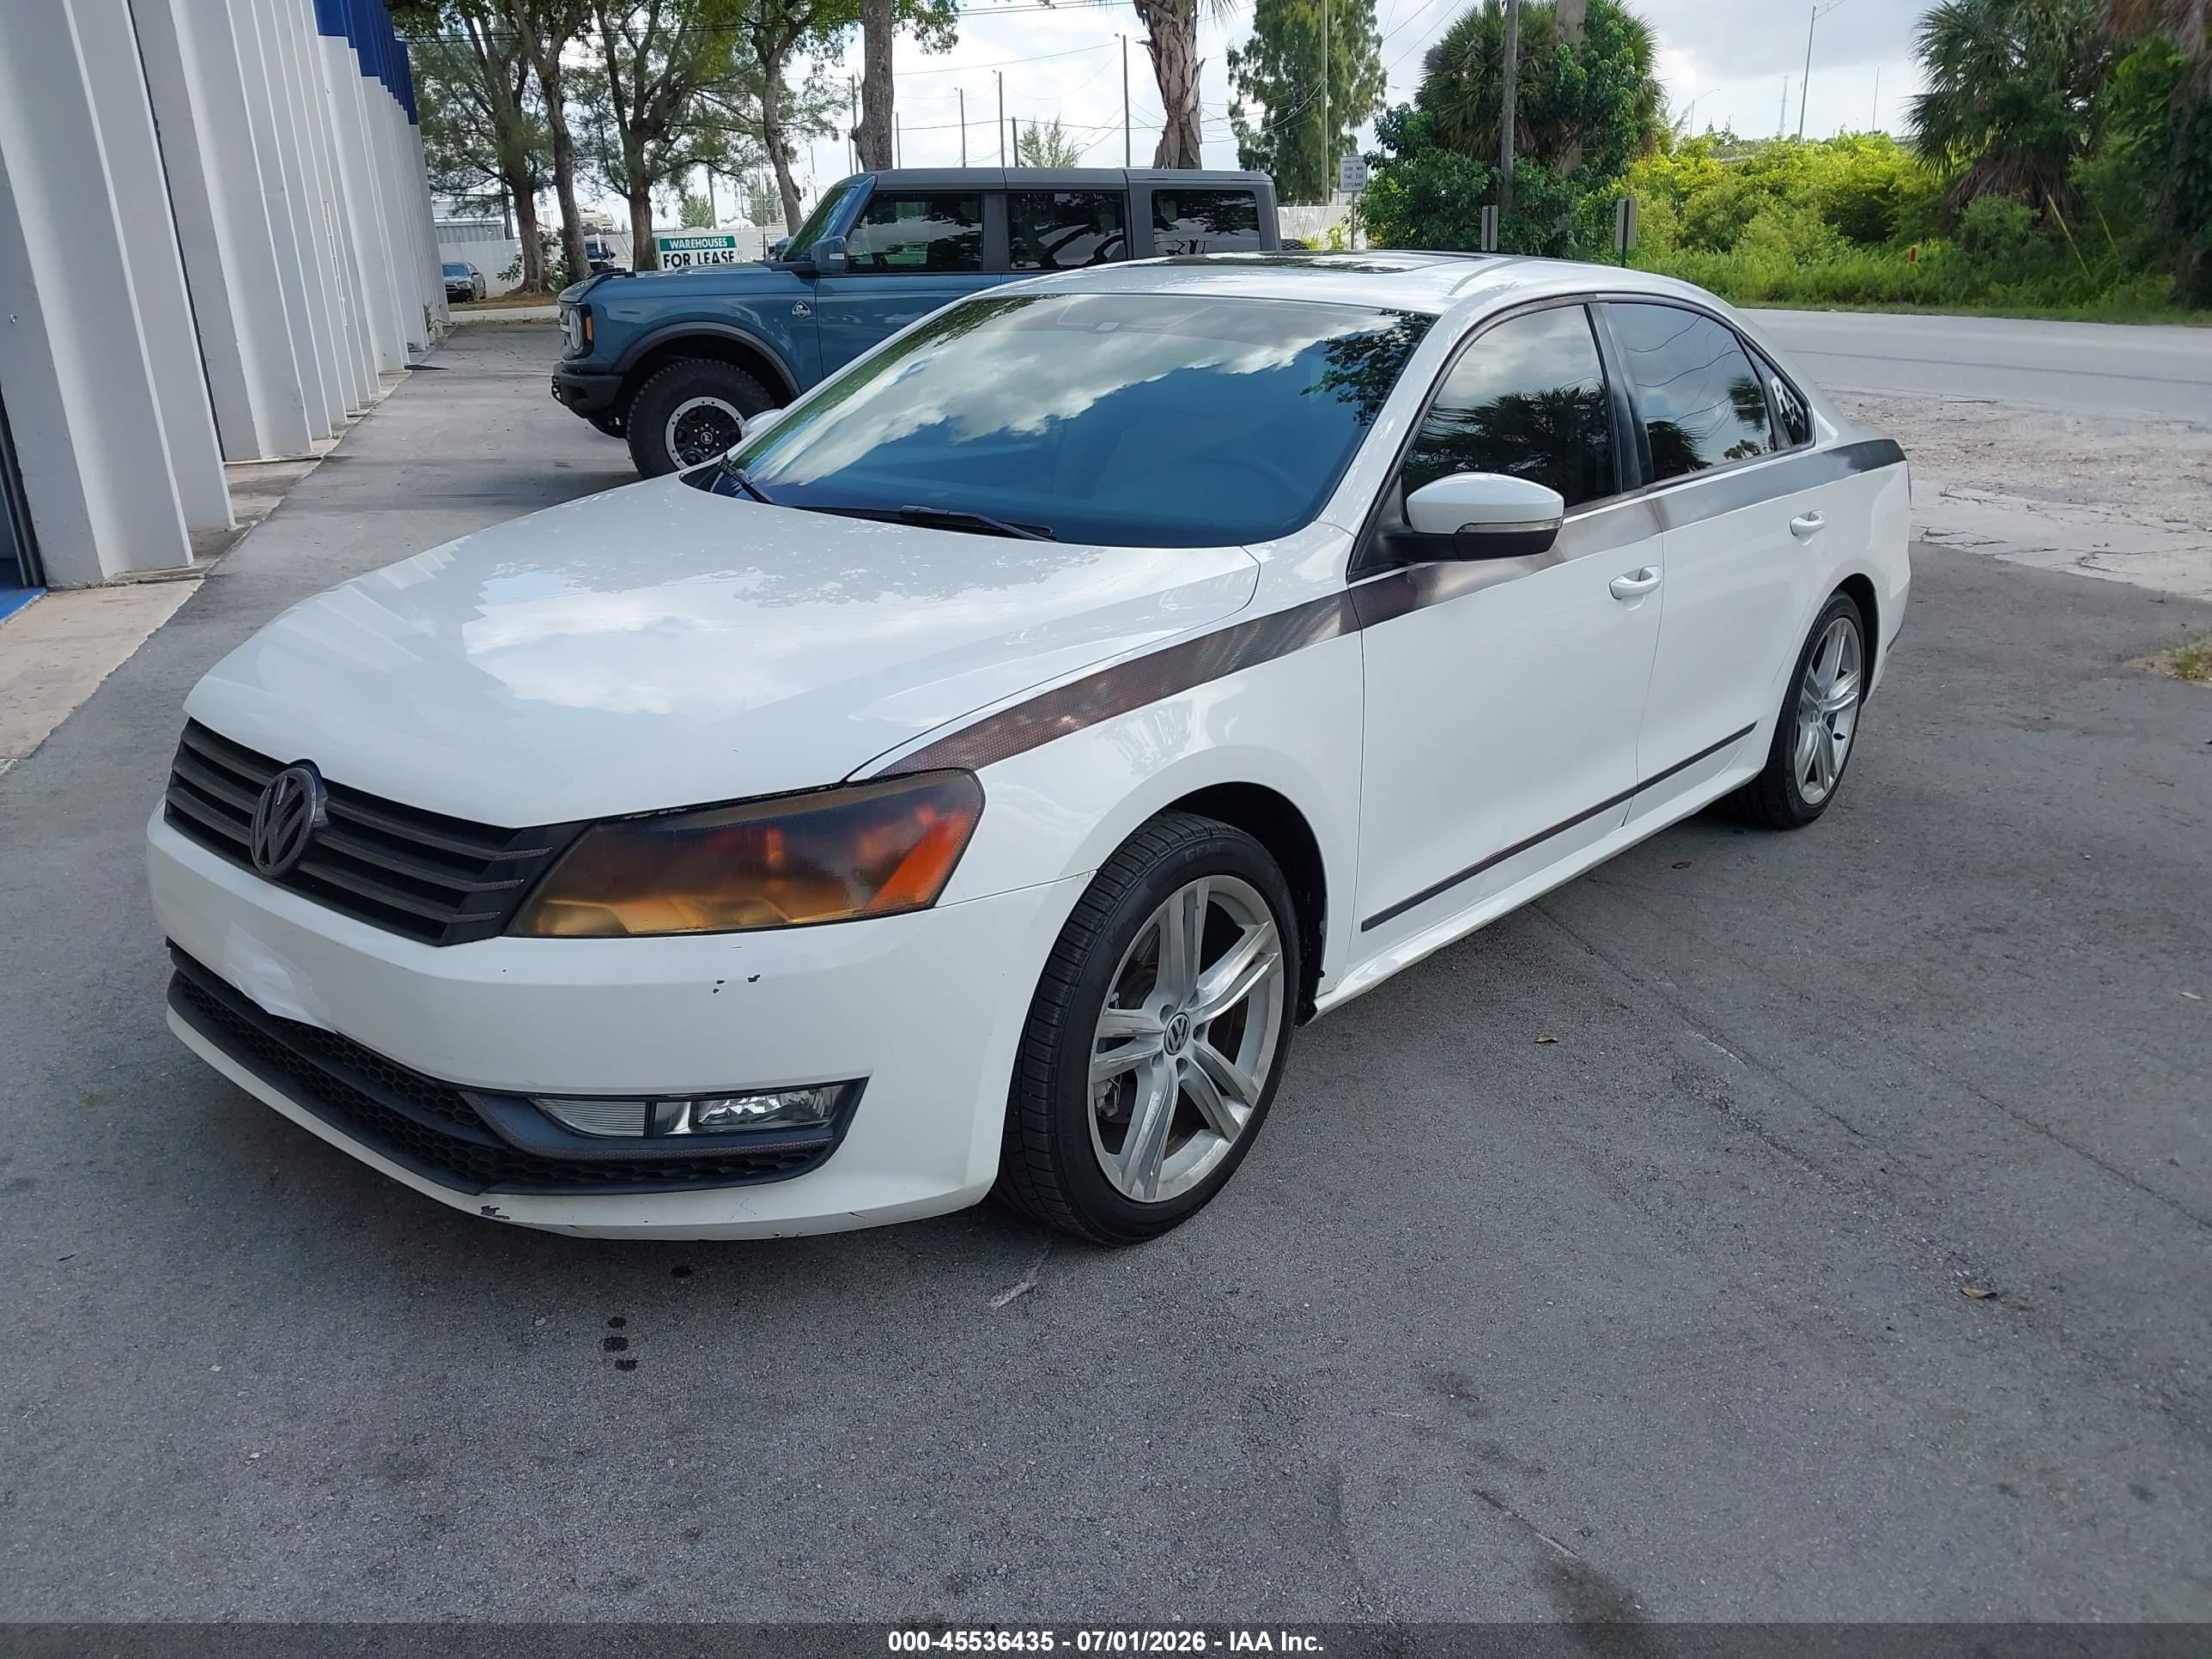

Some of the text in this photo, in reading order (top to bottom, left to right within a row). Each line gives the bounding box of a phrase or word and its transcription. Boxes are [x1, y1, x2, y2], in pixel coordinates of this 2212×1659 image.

[668, 237, 727, 250] WAREHOUSES
[663, 251, 735, 268] FOR LEASE
